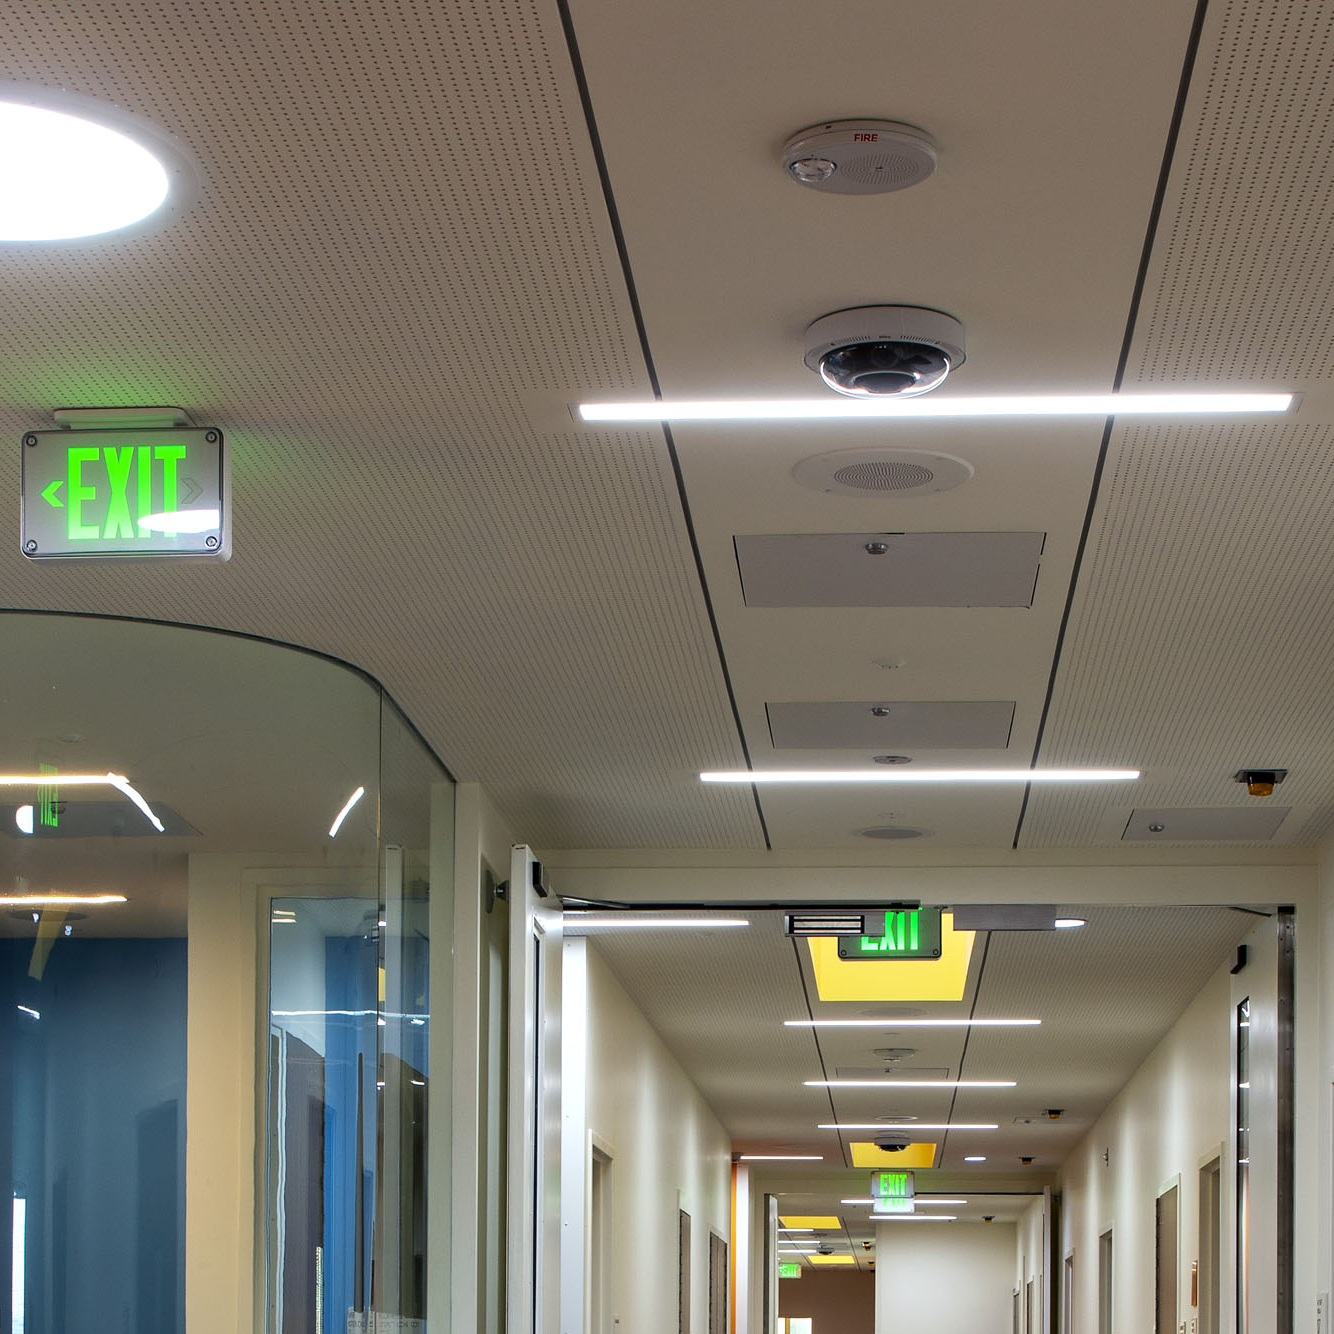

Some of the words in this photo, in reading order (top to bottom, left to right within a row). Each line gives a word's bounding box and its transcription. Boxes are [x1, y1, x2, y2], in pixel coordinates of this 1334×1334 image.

[853, 133, 879, 143] FIRE
[67, 445, 187, 540] EXIT
[879, 1173, 908, 1196] EXIT
